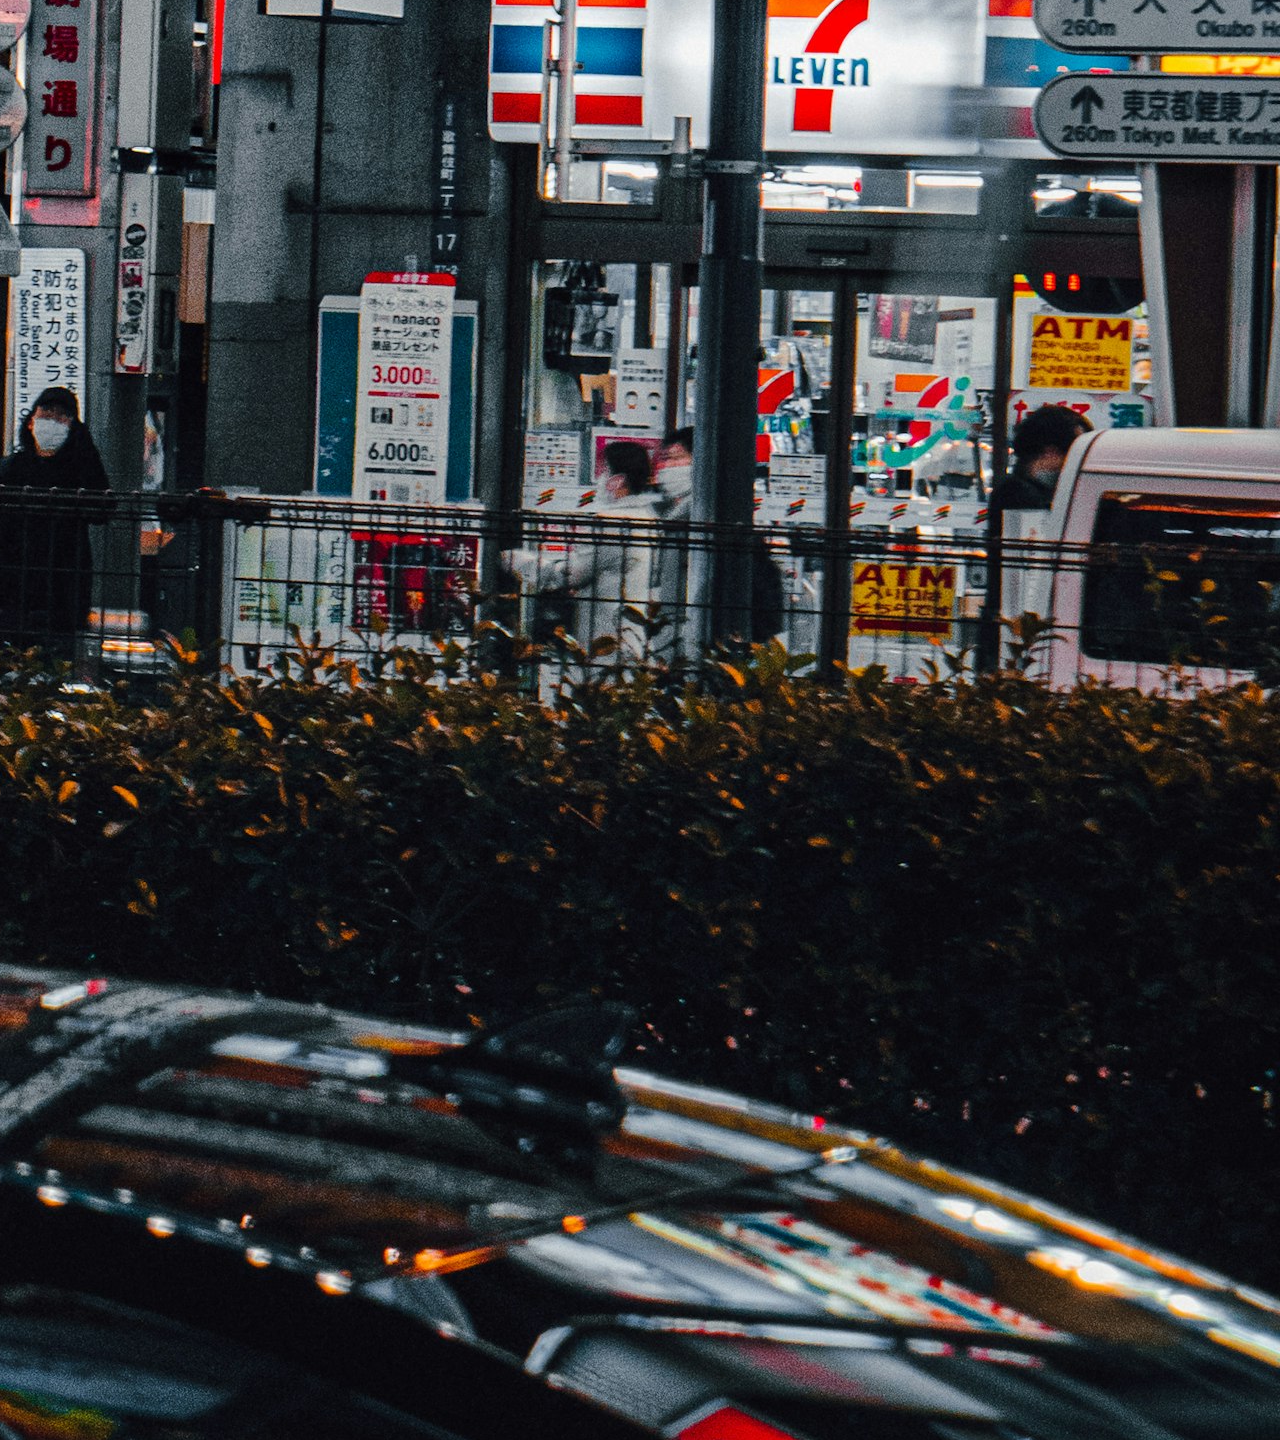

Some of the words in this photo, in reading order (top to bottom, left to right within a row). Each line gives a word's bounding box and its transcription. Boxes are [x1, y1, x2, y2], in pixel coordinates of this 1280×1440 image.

[1061, 18, 1117, 37] 260m
[1061, 124, 1117, 143] 260m
[1121, 126, 1176, 147] Tokyo
[437, 233, 457, 251] 17
[32, 269, 42, 287] For
[19, 289, 32, 338] Security
[32, 293, 42, 319] Your
[44, 269, 62, 382] 防犯カメラ
[393, 313, 440, 326] nanaco
[1034, 317, 1131, 341] ATM
[31, 325, 42, 362] Safety
[18, 343, 31, 389] Camera
[18, 393, 28, 404] in
[853, 564, 954, 589] ATM
